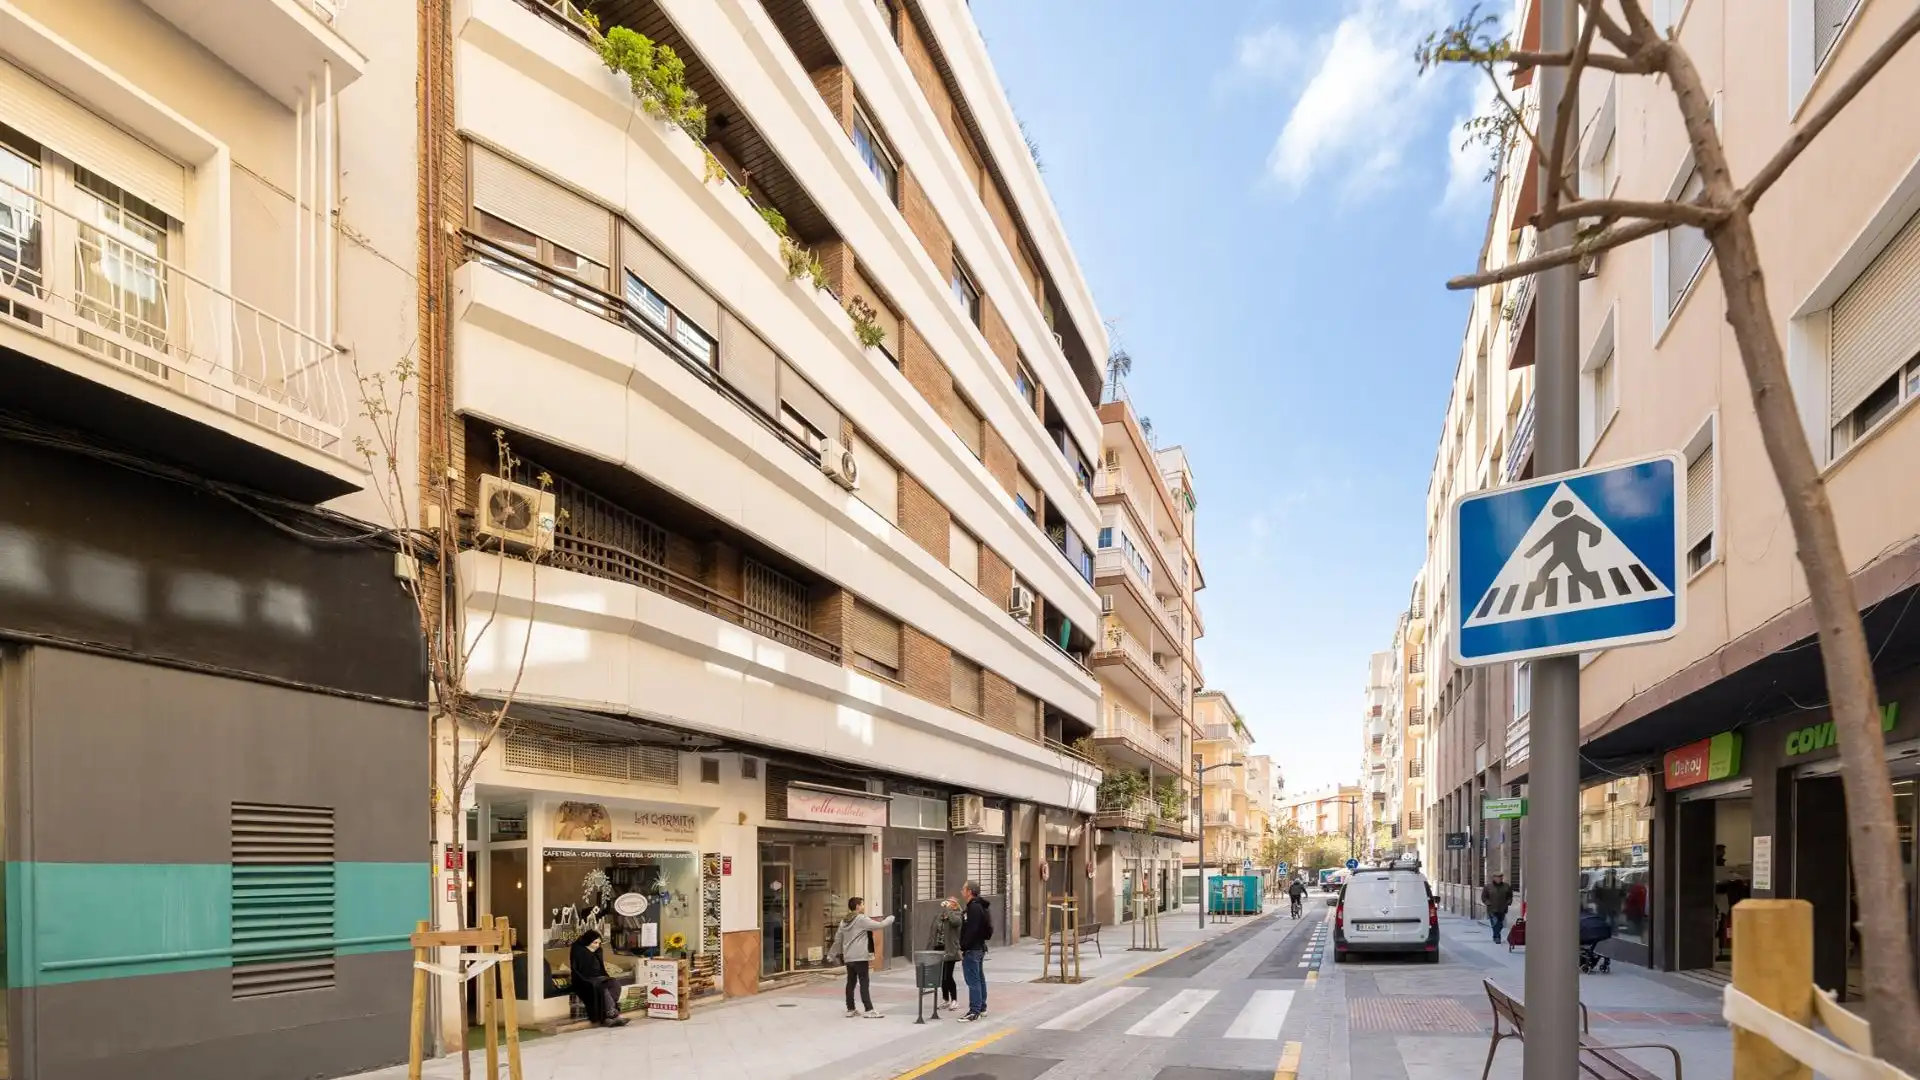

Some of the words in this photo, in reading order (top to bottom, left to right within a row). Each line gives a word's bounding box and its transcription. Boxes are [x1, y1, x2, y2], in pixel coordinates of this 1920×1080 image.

[543, 849, 577, 857] CAFETERÍA
[580, 850, 612, 858] CAFETERÍA
[615, 851, 644, 859] CAFETERÍA
